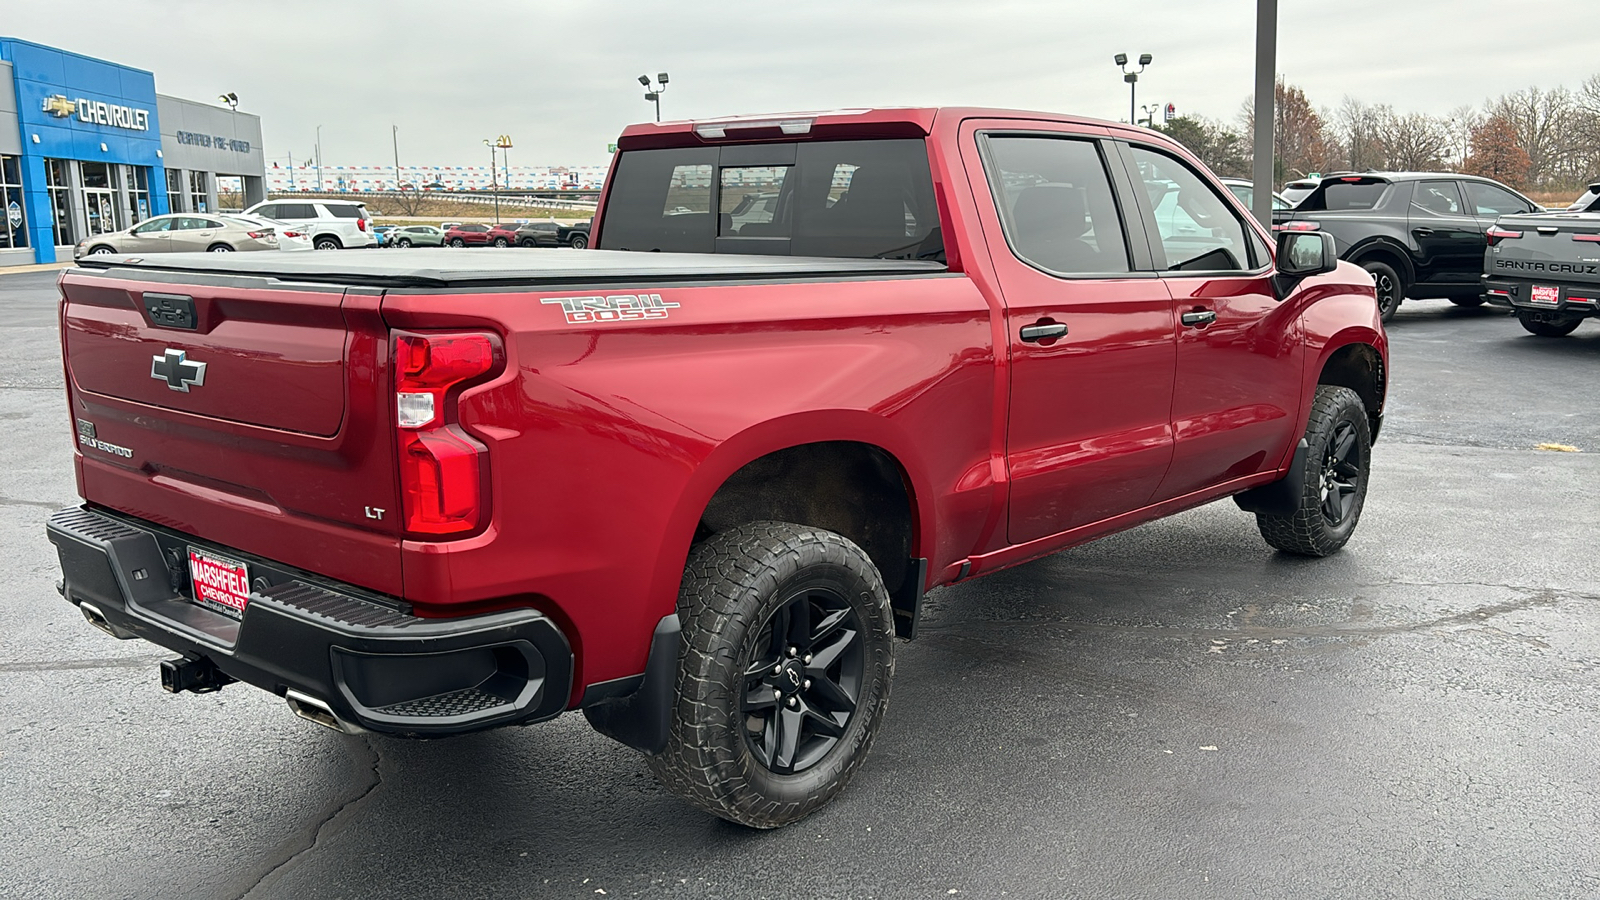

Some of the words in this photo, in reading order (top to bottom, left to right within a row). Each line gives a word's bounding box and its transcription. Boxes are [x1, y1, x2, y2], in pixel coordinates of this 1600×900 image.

[78, 98, 149, 131] CHEVROLET
[1496, 260, 1545, 271] SANTA
[1549, 263, 1598, 275] CRUZ
[540, 294, 680, 312] TRAIL
[565, 308, 668, 324] BOSS
[79, 434, 133, 458] SILVERADO
[365, 506, 386, 520] LT
[191, 560, 249, 598] MARSHFIELD
[200, 584, 245, 611] CHEVROLET
